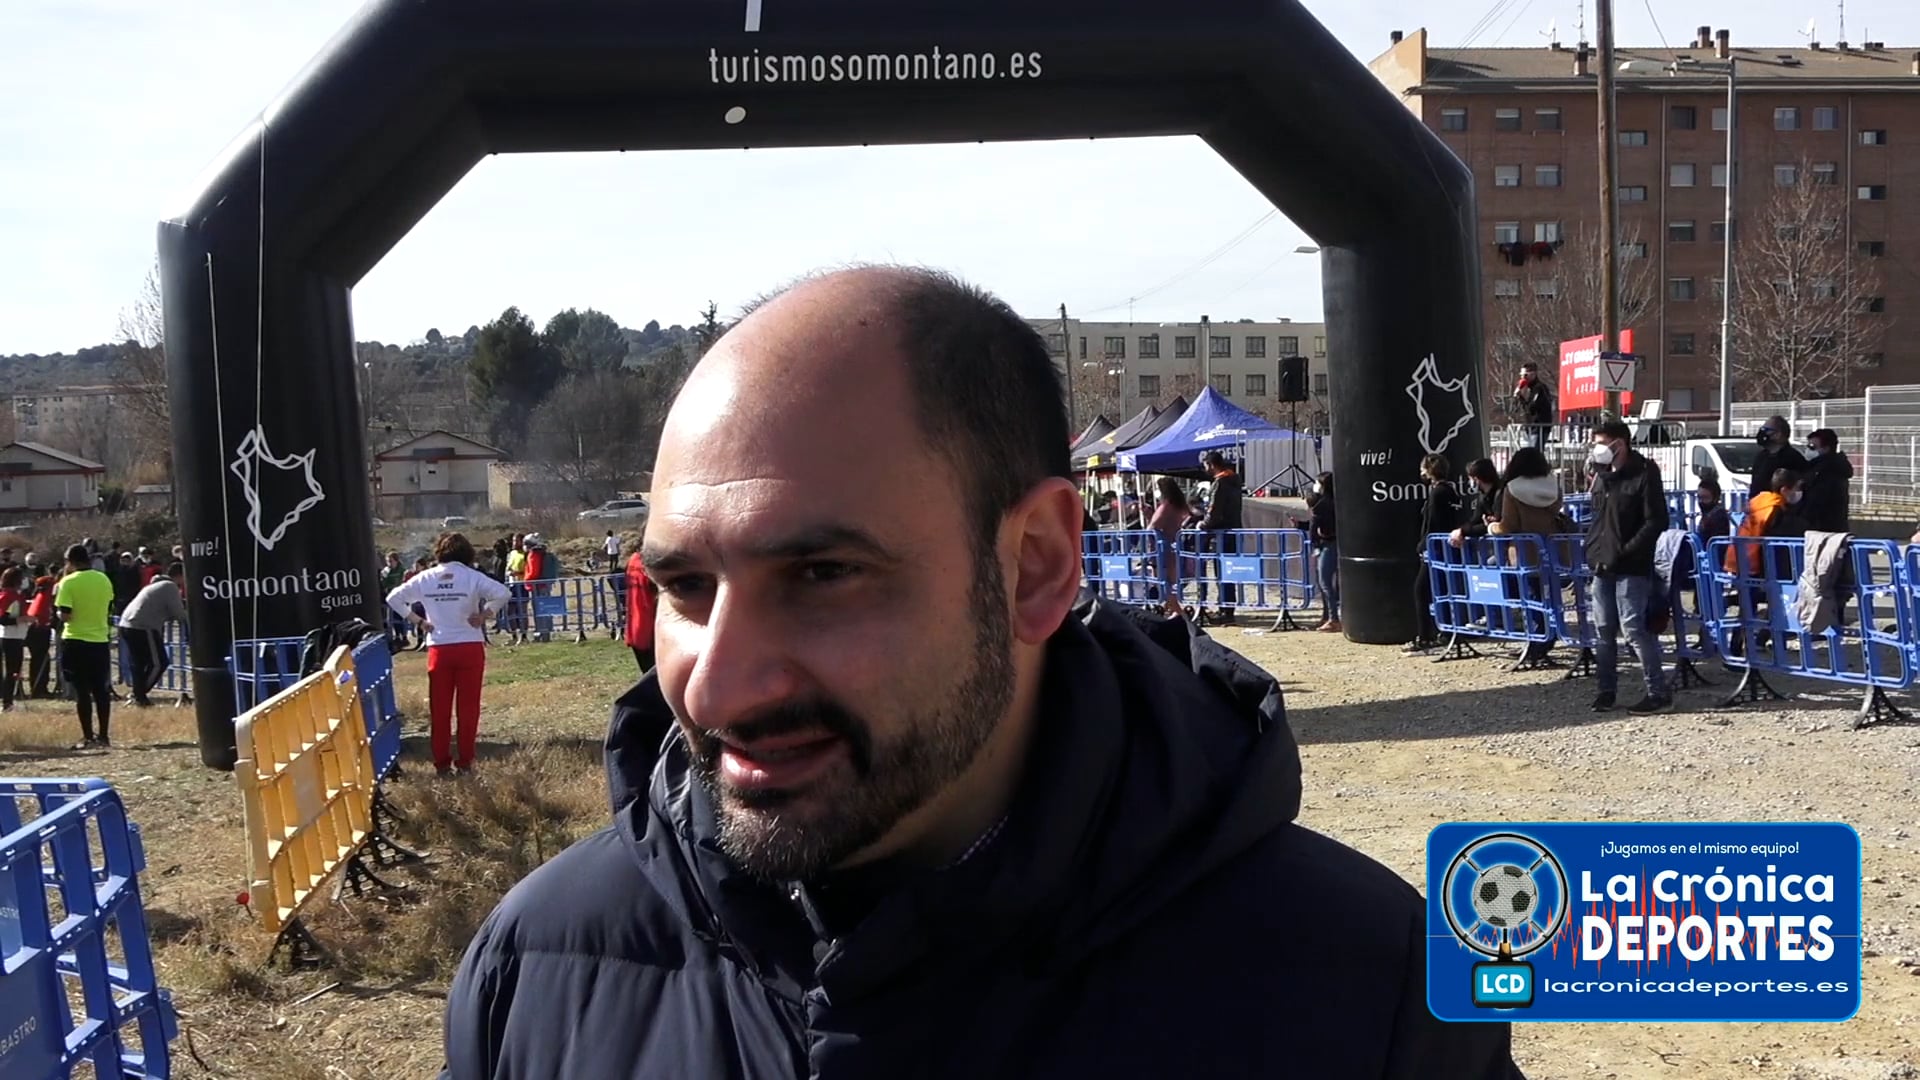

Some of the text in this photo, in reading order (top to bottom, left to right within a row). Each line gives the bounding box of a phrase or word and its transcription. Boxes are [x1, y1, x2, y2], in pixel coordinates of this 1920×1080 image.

[709, 46, 1042, 83] turismosomontano.es
[1360, 448, 1392, 466] vive!
[202, 567, 361, 600] Somontano
[320, 593, 362, 613] guara
